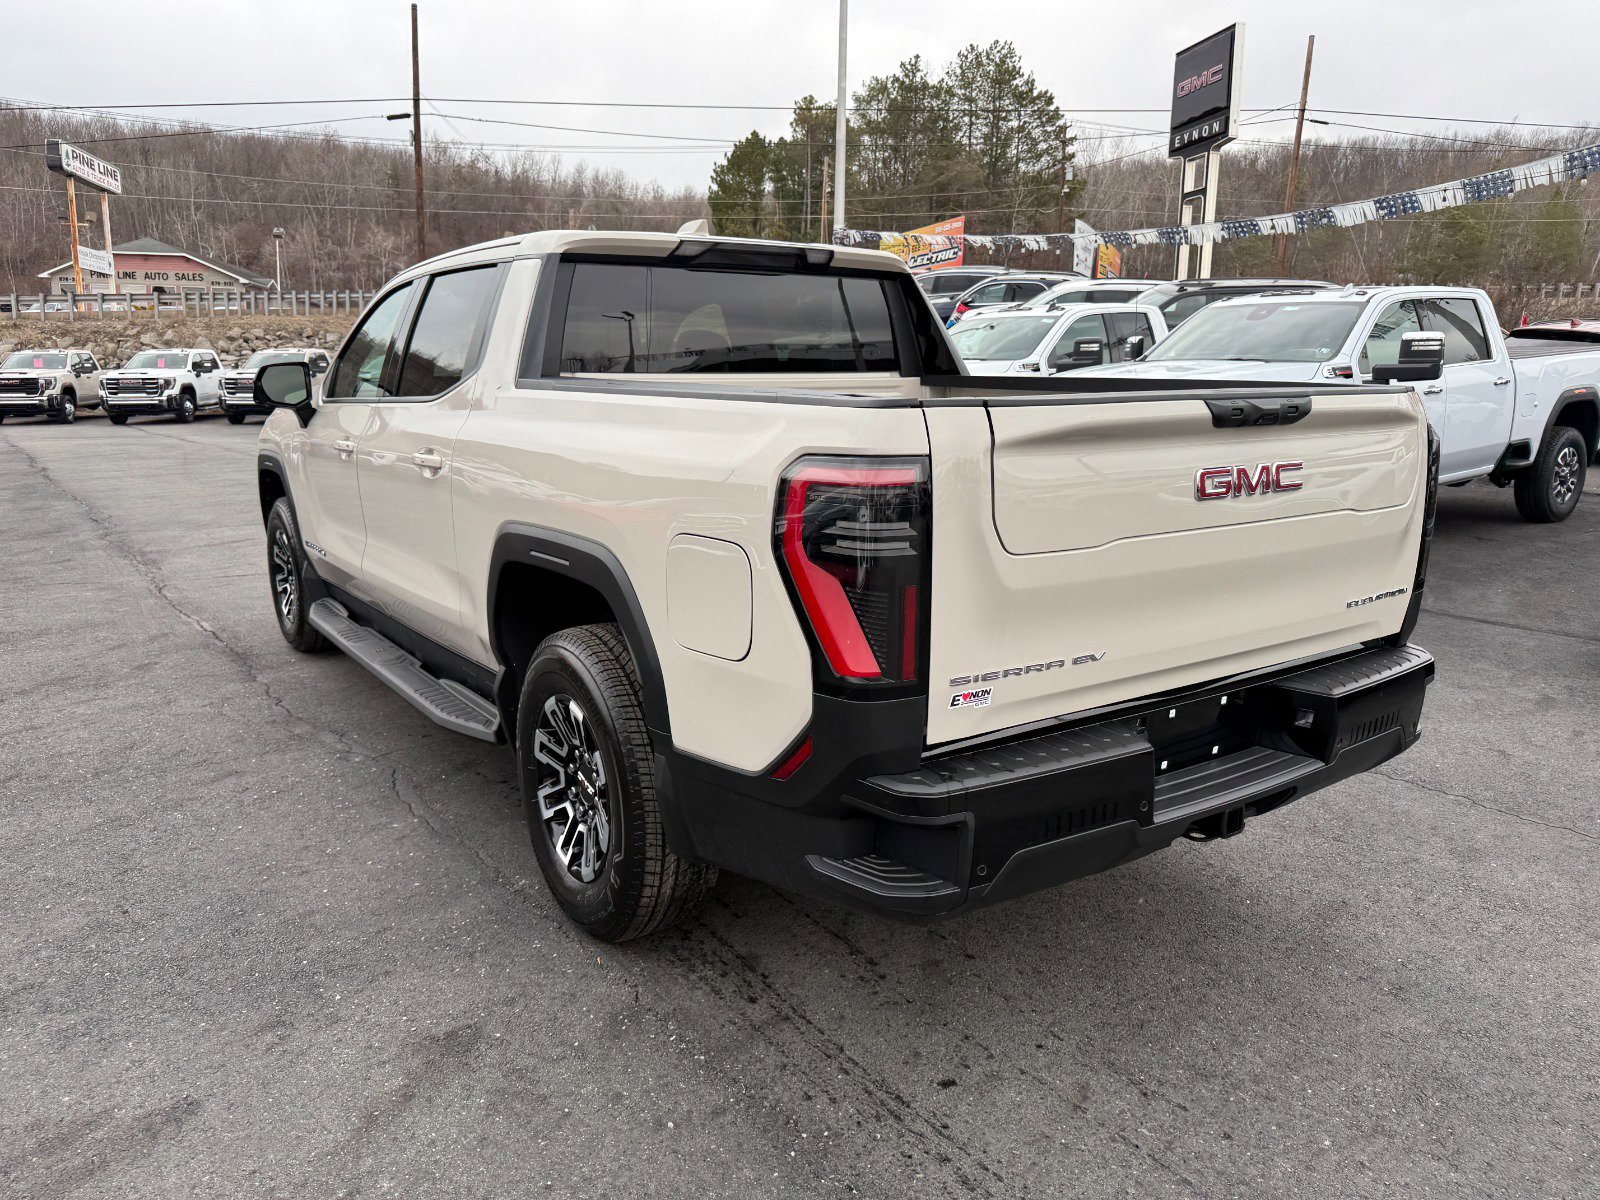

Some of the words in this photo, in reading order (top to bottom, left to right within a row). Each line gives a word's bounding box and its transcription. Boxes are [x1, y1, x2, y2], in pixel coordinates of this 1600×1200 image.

[1177, 63, 1223, 98] GMC
[1174, 120, 1220, 148] EYNON
[71, 149, 96, 172] PINE
[97, 162, 119, 182] LINE
[72, 164, 86, 176] AUTO
[91, 172, 106, 185] TRUCK
[907, 248, 959, 268] LECTRIC
[117, 270, 137, 280] LINE
[144, 271, 169, 281] AUTO
[174, 272, 204, 282] SALES
[1194, 459, 1304, 501] GMC
[949, 659, 1066, 686] SIERRA
[1071, 650, 1107, 666] EV
